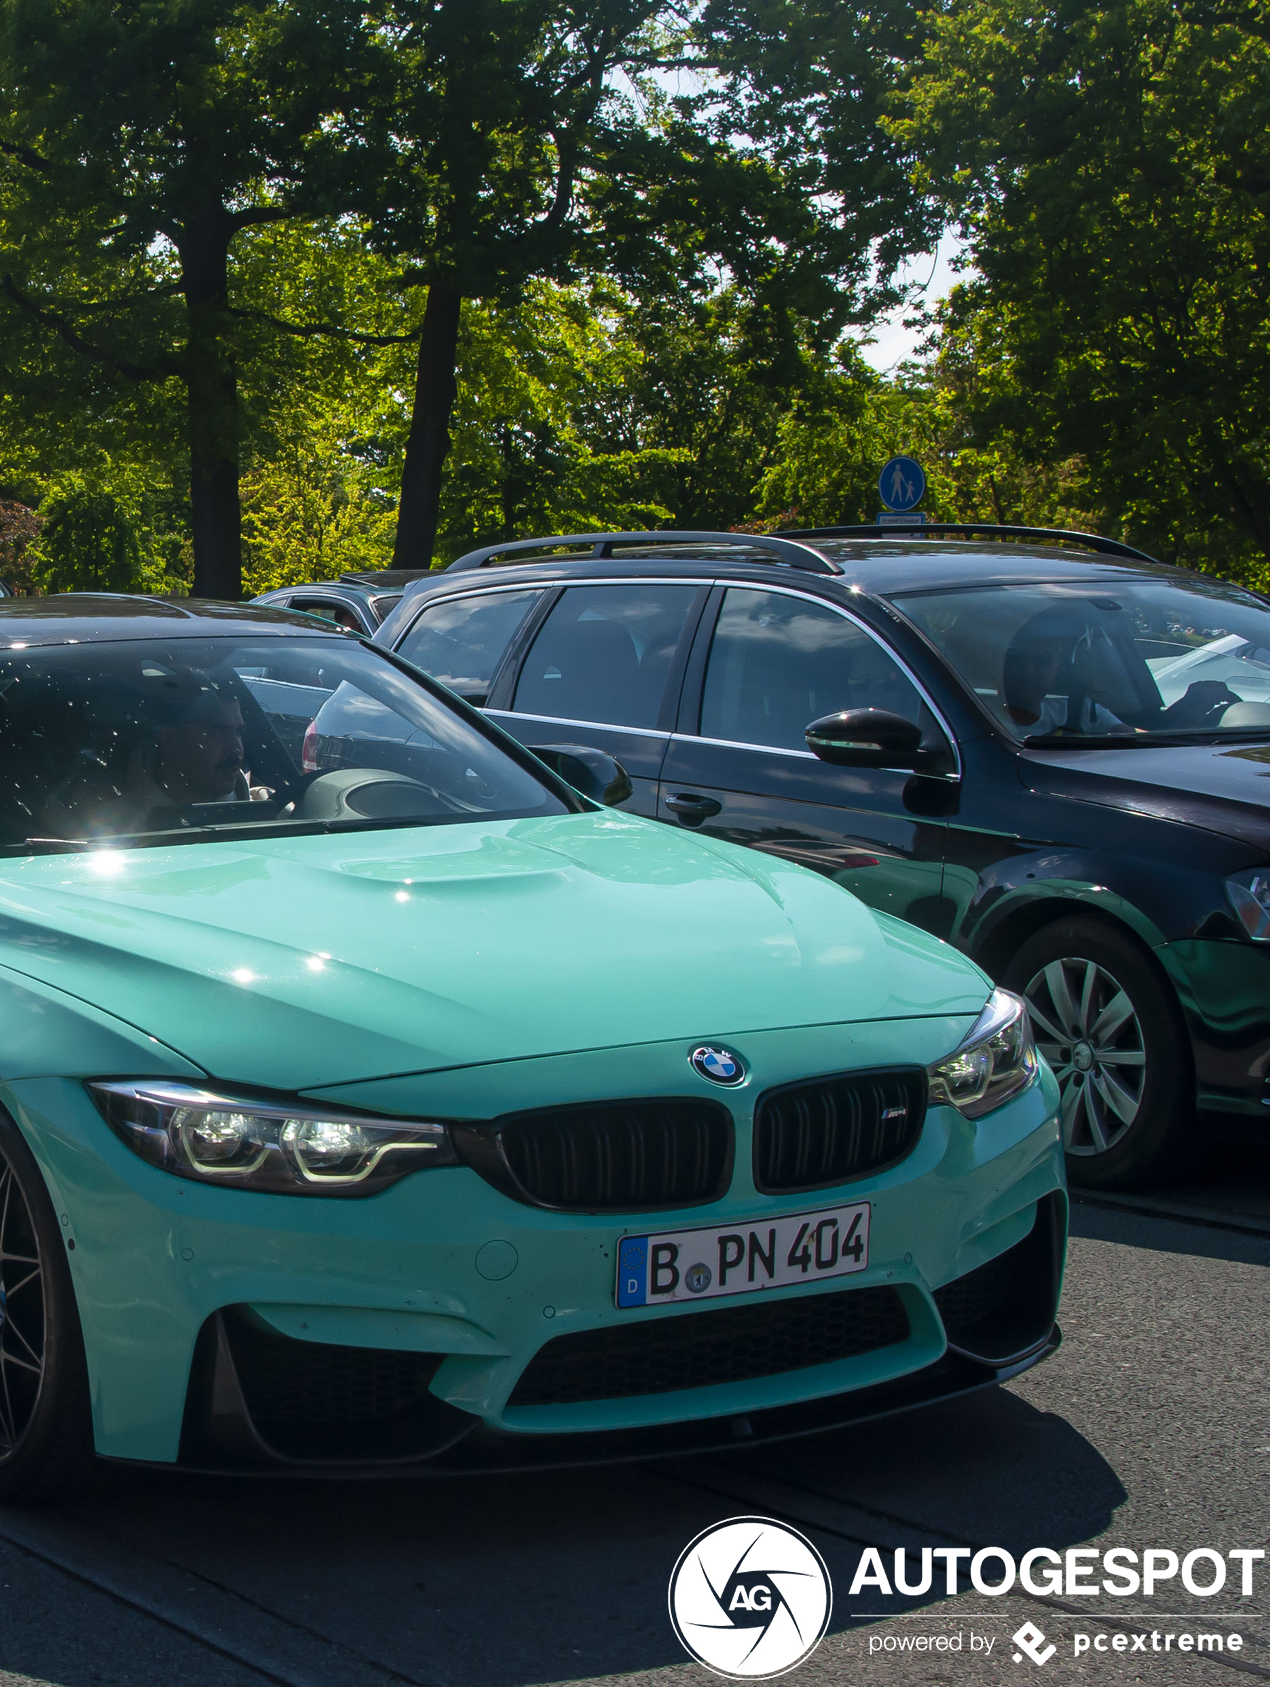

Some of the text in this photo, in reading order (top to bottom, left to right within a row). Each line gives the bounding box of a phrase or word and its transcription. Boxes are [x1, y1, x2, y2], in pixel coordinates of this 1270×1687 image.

[694, 1047, 732, 1061] BMW
[650, 1212, 863, 1295] B PN 404
[628, 1279, 638, 1294] D
